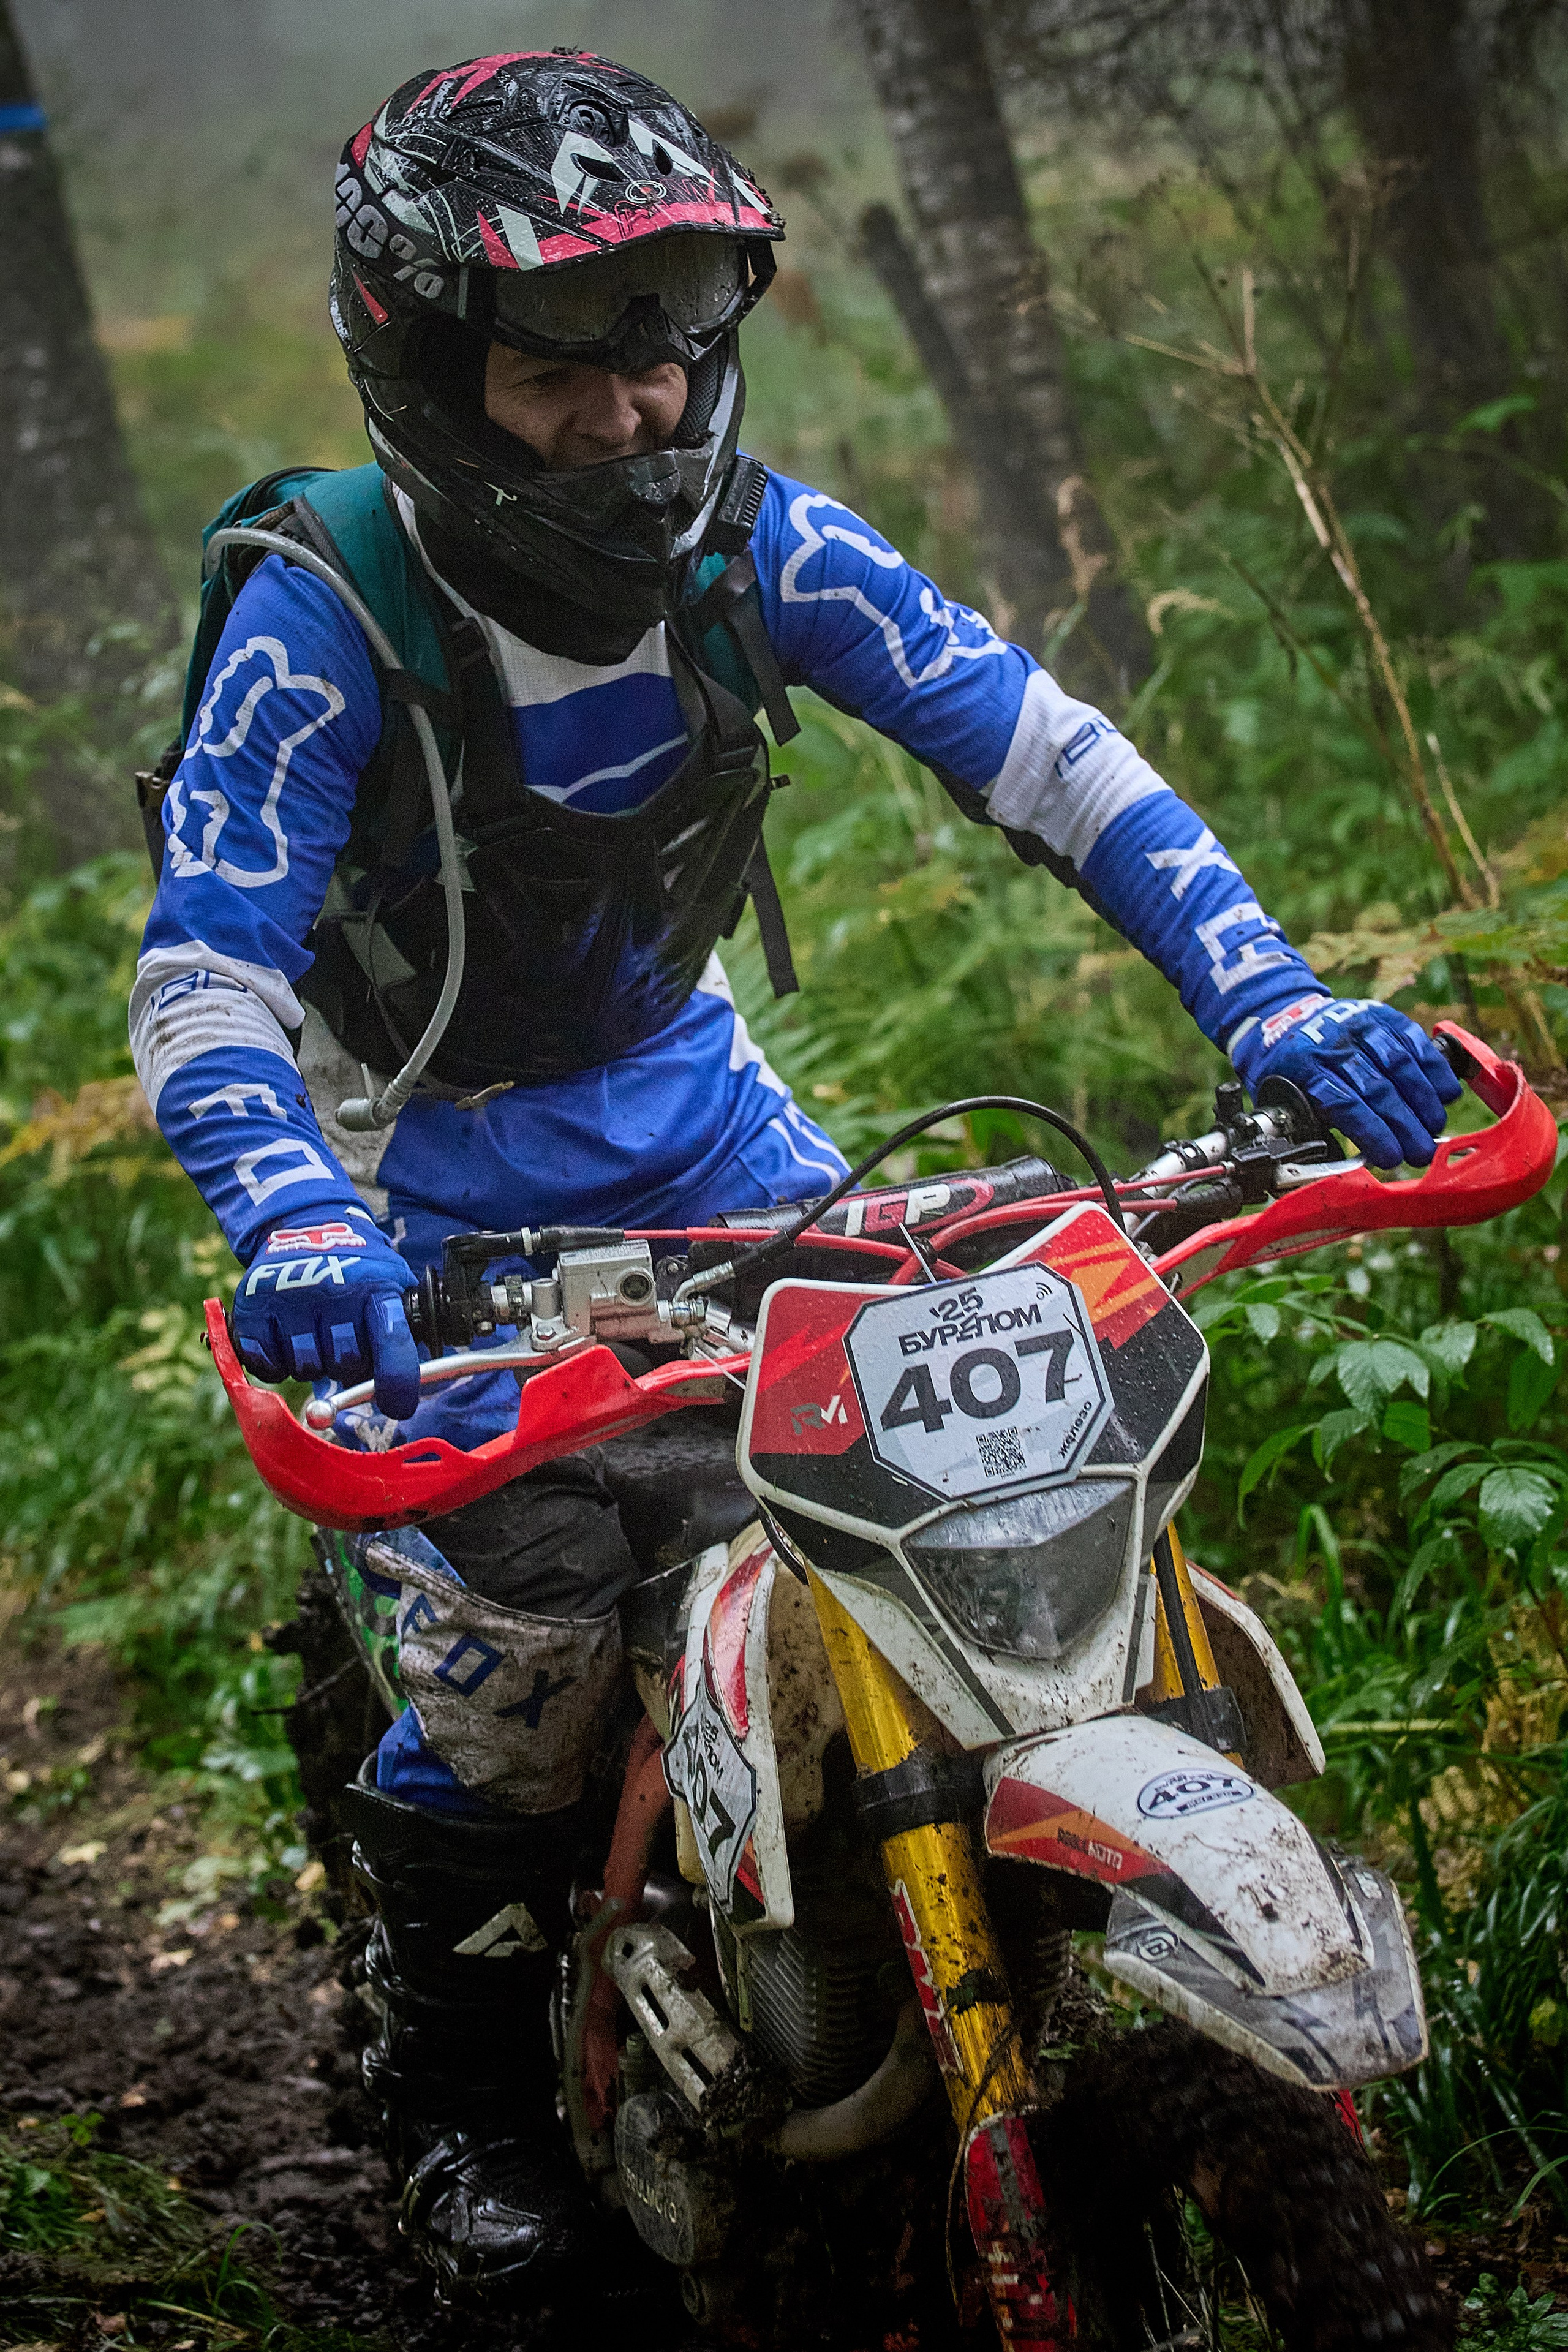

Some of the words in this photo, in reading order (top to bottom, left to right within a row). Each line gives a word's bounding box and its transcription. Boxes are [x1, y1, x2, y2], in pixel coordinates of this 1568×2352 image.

[246, 1256, 361, 1297] FOX
[898, 1303, 1043, 1357] БУРЕЛОМ
[879, 1330, 1076, 1433] 407
[401, 1593, 577, 1729] FOX
